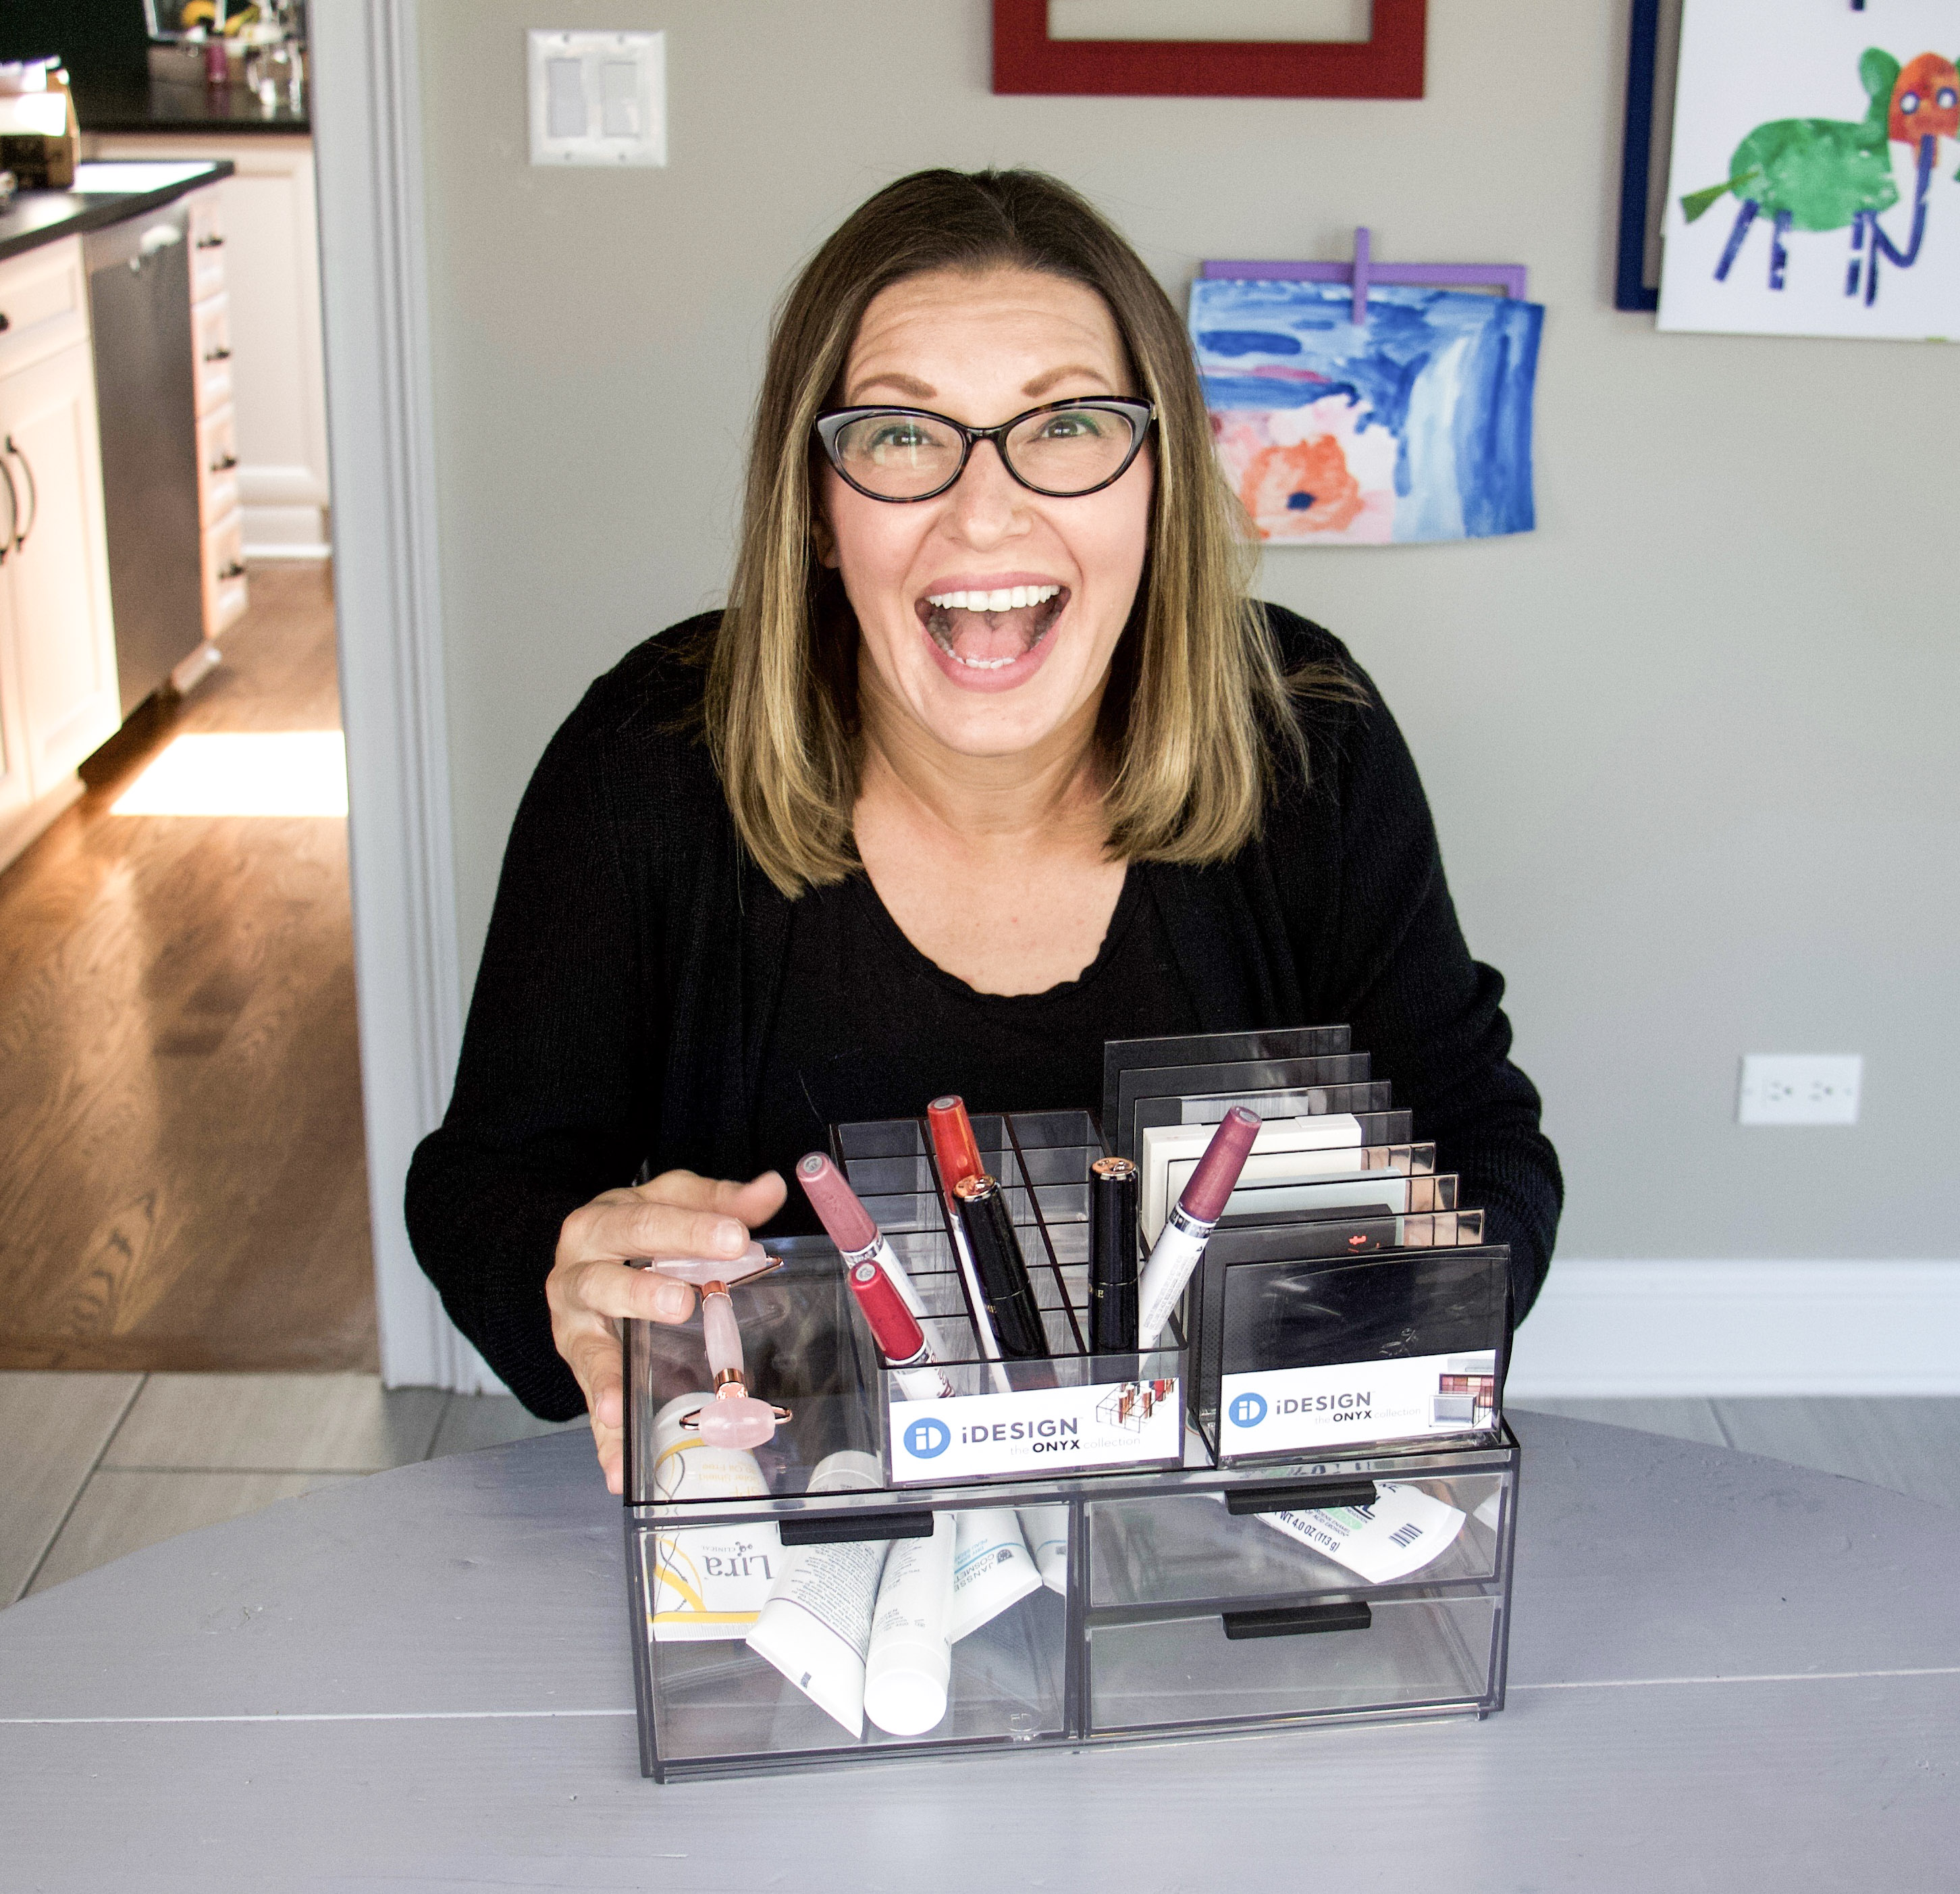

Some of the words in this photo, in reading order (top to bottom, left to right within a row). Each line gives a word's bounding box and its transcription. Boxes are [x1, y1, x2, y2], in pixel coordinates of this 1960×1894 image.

[1276, 1392, 1371, 1415] iDESIGN
[1333, 1411, 1372, 1422] ONYX
[962, 1417, 1078, 1444] iDESIGN
[1011, 1444, 1029, 1455] the
[1032, 1440, 1080, 1452] ONYX
[1083, 1438, 1140, 1450] collection
[1280, 1510, 1294, 1523] WT
[1292, 1518, 1304, 1531] 4.0
[1304, 1525, 1317, 1537] OZ
[1315, 1531, 1331, 1546] (113
[1329, 1542, 1340, 1552] g)
[702, 1555, 775, 1580] Lira
